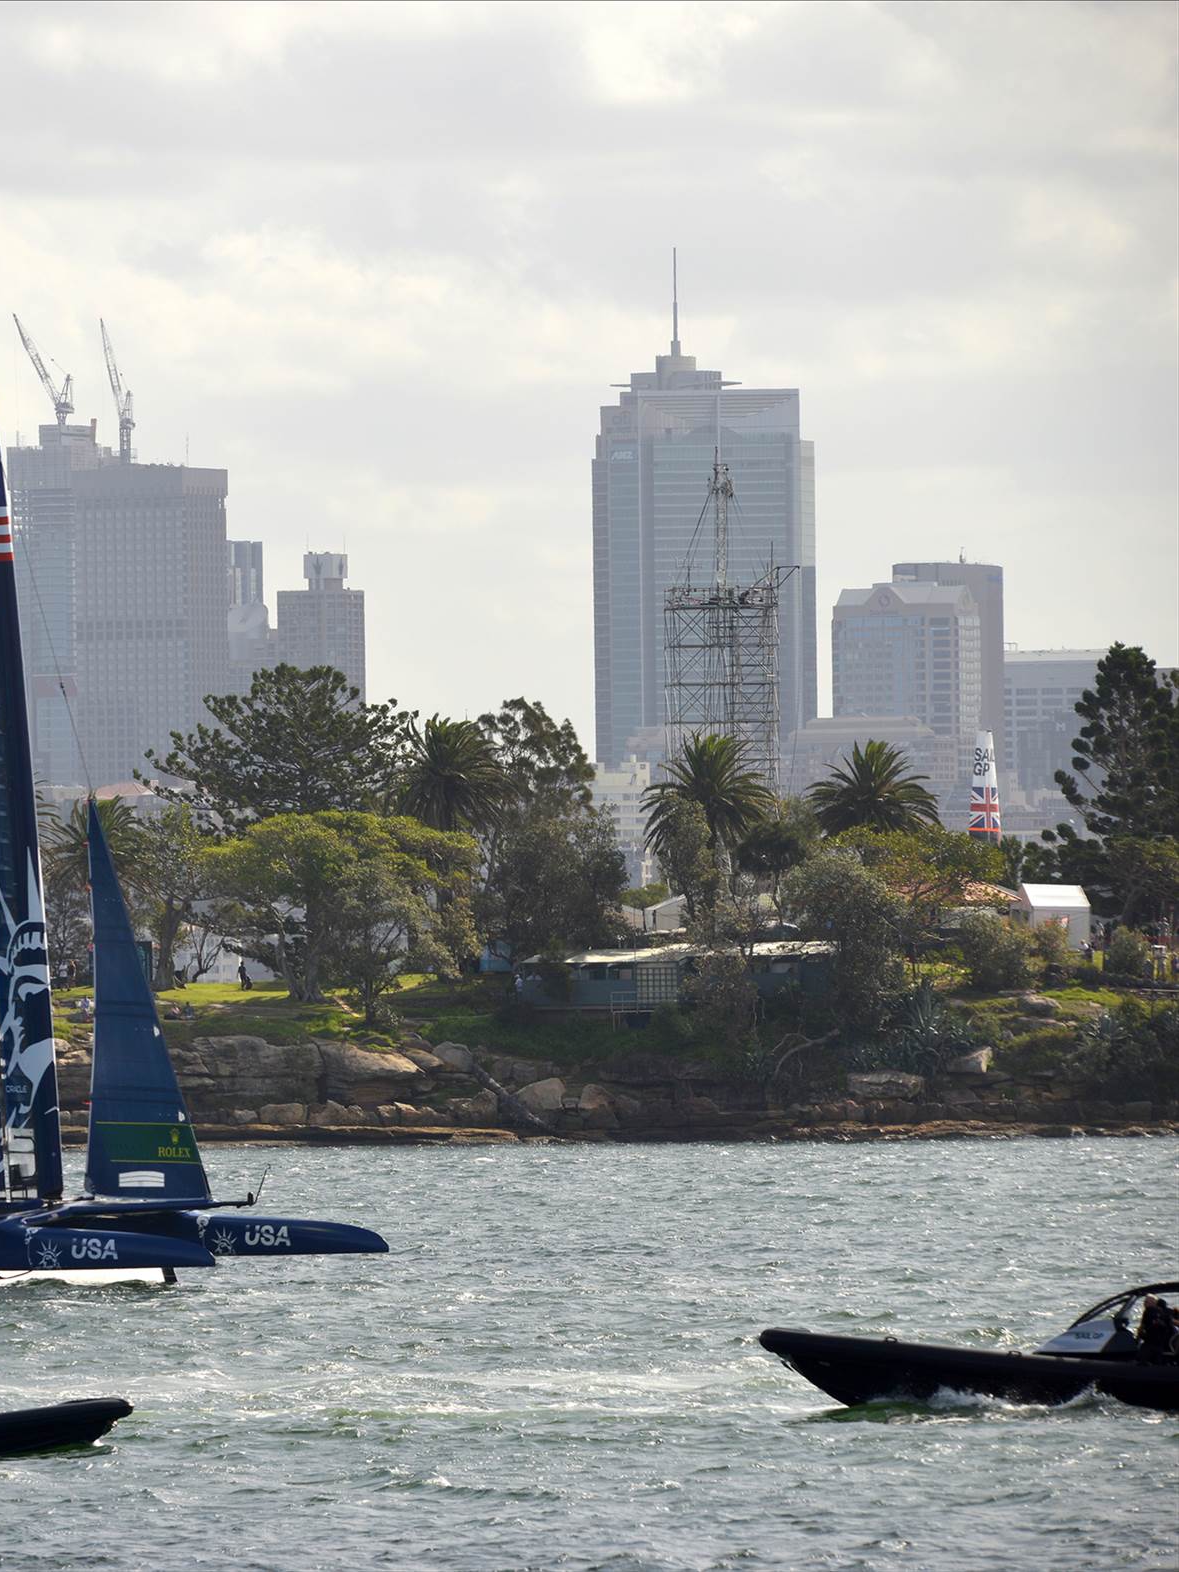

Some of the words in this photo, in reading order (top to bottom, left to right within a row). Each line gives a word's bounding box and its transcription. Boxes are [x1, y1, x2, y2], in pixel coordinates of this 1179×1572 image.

[974, 747, 995, 762] SAIL
[973, 762, 990, 776] GP
[5, 1084, 27, 1093] ORACLE
[157, 1146, 191, 1158] ROLEX
[243, 1224, 292, 1247] USA
[70, 1237, 119, 1261] USA
